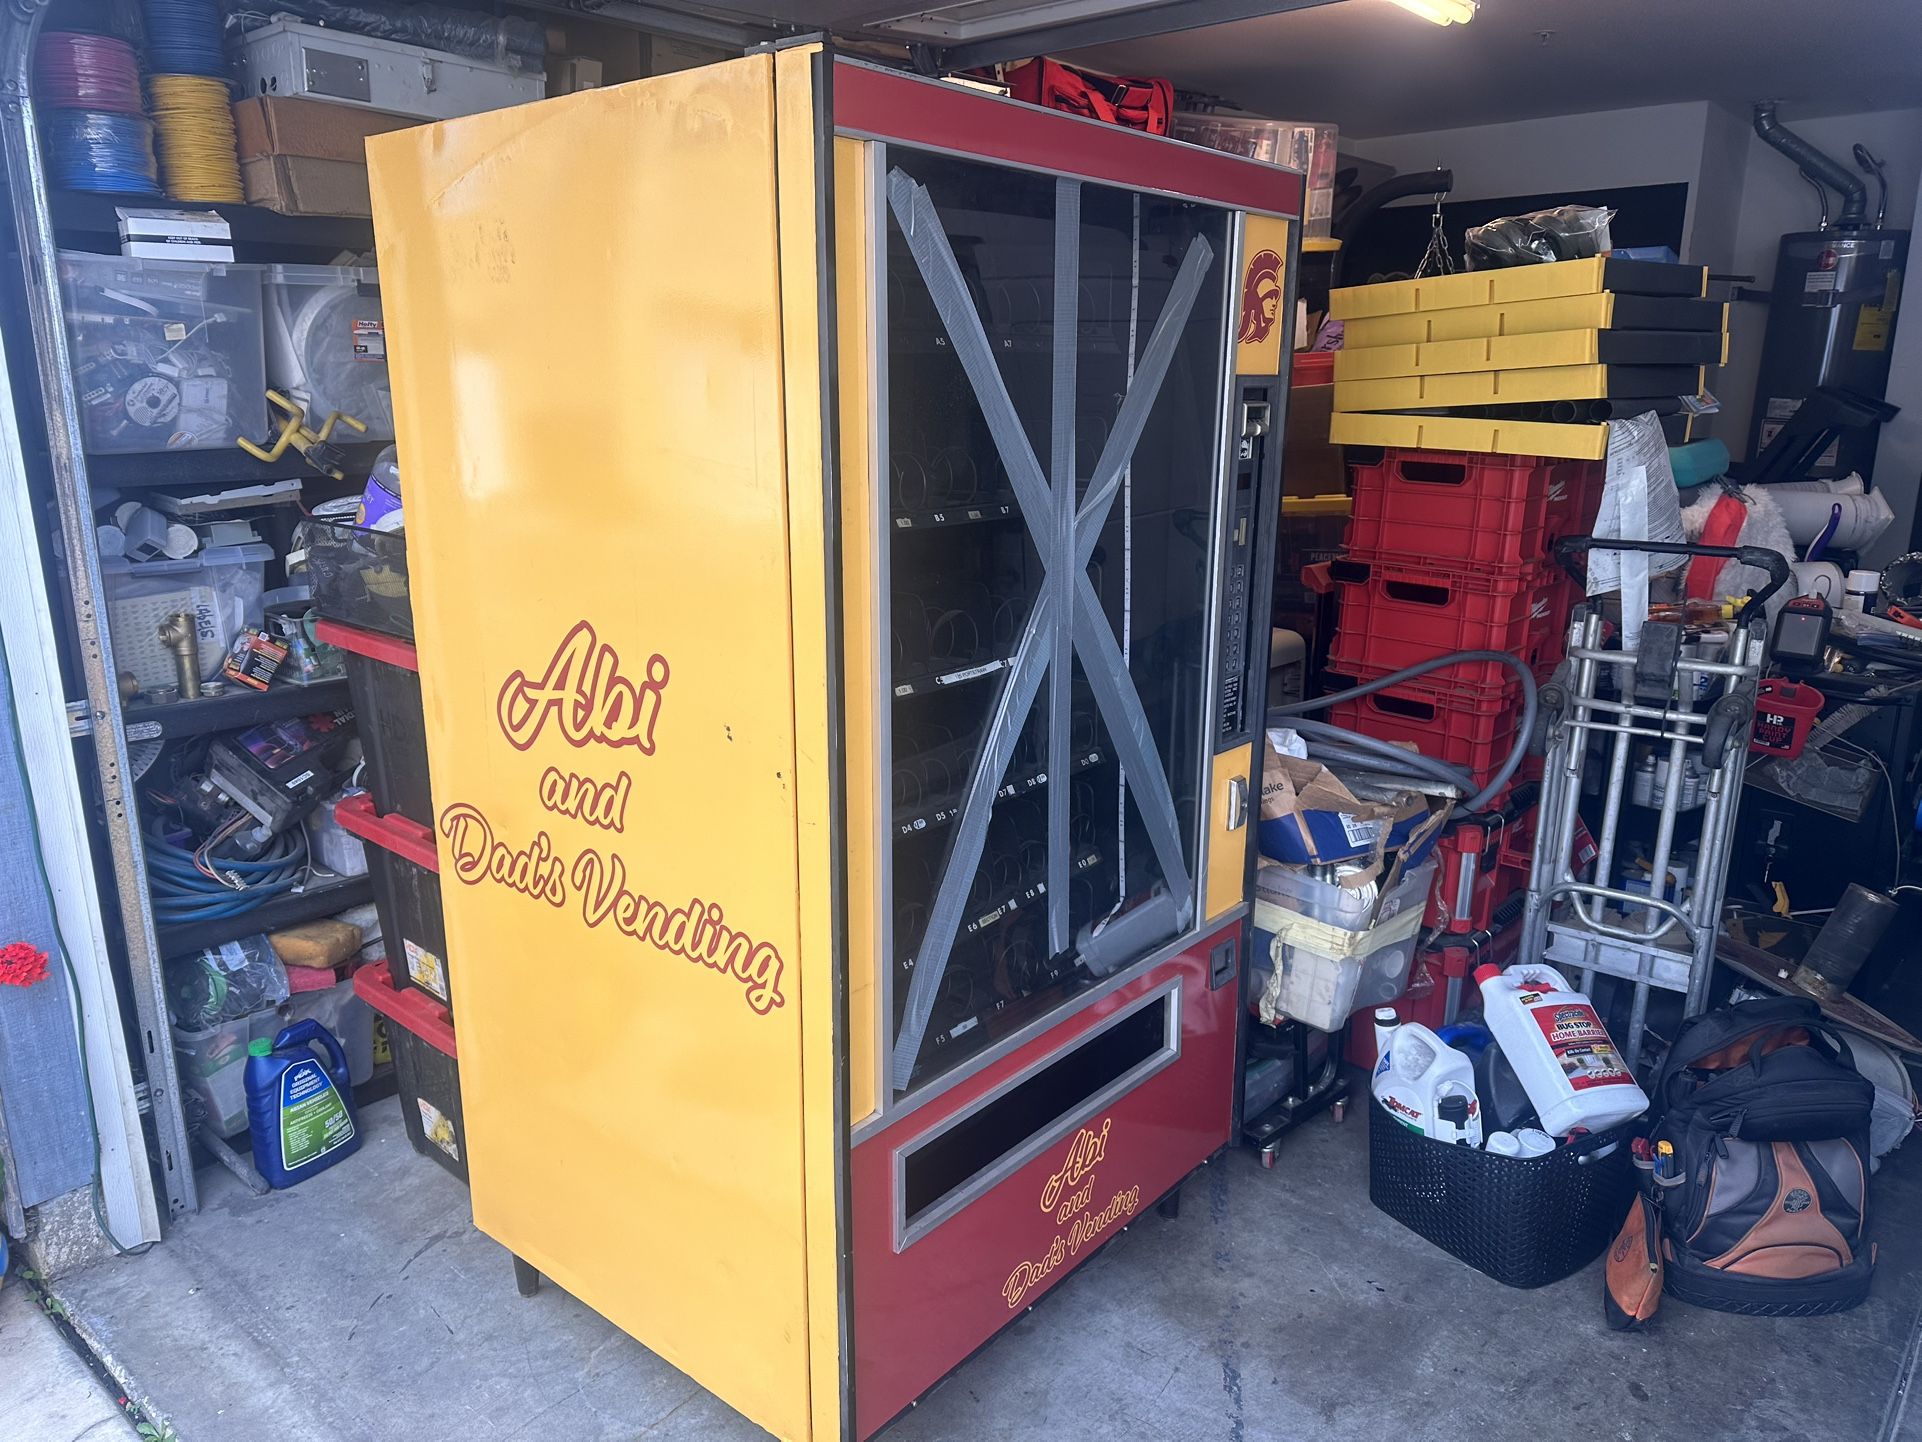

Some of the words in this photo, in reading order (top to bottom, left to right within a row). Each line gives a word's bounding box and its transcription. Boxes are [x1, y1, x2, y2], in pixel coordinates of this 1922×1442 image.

[934, 513, 945, 522] B5
[497, 619, 670, 756] Abi
[998, 787, 1007, 797] D7
[539, 766, 632, 834] and
[935, 811, 946, 821] D5
[902, 823, 912, 833] D4
[1025, 888, 1034, 899] E8
[440, 803, 566, 908] Dad's
[572, 848, 786, 1016] Vending
[967, 921, 977, 932] E6
[997, 904, 1006, 915] E7
[903, 958, 914, 970] E4
[996, 1000, 1005, 1010] F7
[1556, 1022, 1574, 1031] BUG
[1575, 1021, 1592, 1029] STOP
[935, 1034, 946, 1045] F5
[1551, 1031, 1577, 1041] HOME
[291, 1074, 317, 1088] ORIGINAL
[294, 1069, 312, 1081] PEAK
[290, 1077, 321, 1094] EQUIPMENT
[290, 1081, 323, 1100] TECHNOLOGY
[290, 1101, 307, 1113] ASIAN
[1389, 1095, 1423, 1119] TOMCAT
[325, 1111, 343, 1128] 50/50
[1040, 1118, 1111, 1213] Abi
[1057, 1175, 1095, 1224] and
[1002, 1235, 1066, 1309] Dad's
[1067, 1185, 1139, 1256] Vending
